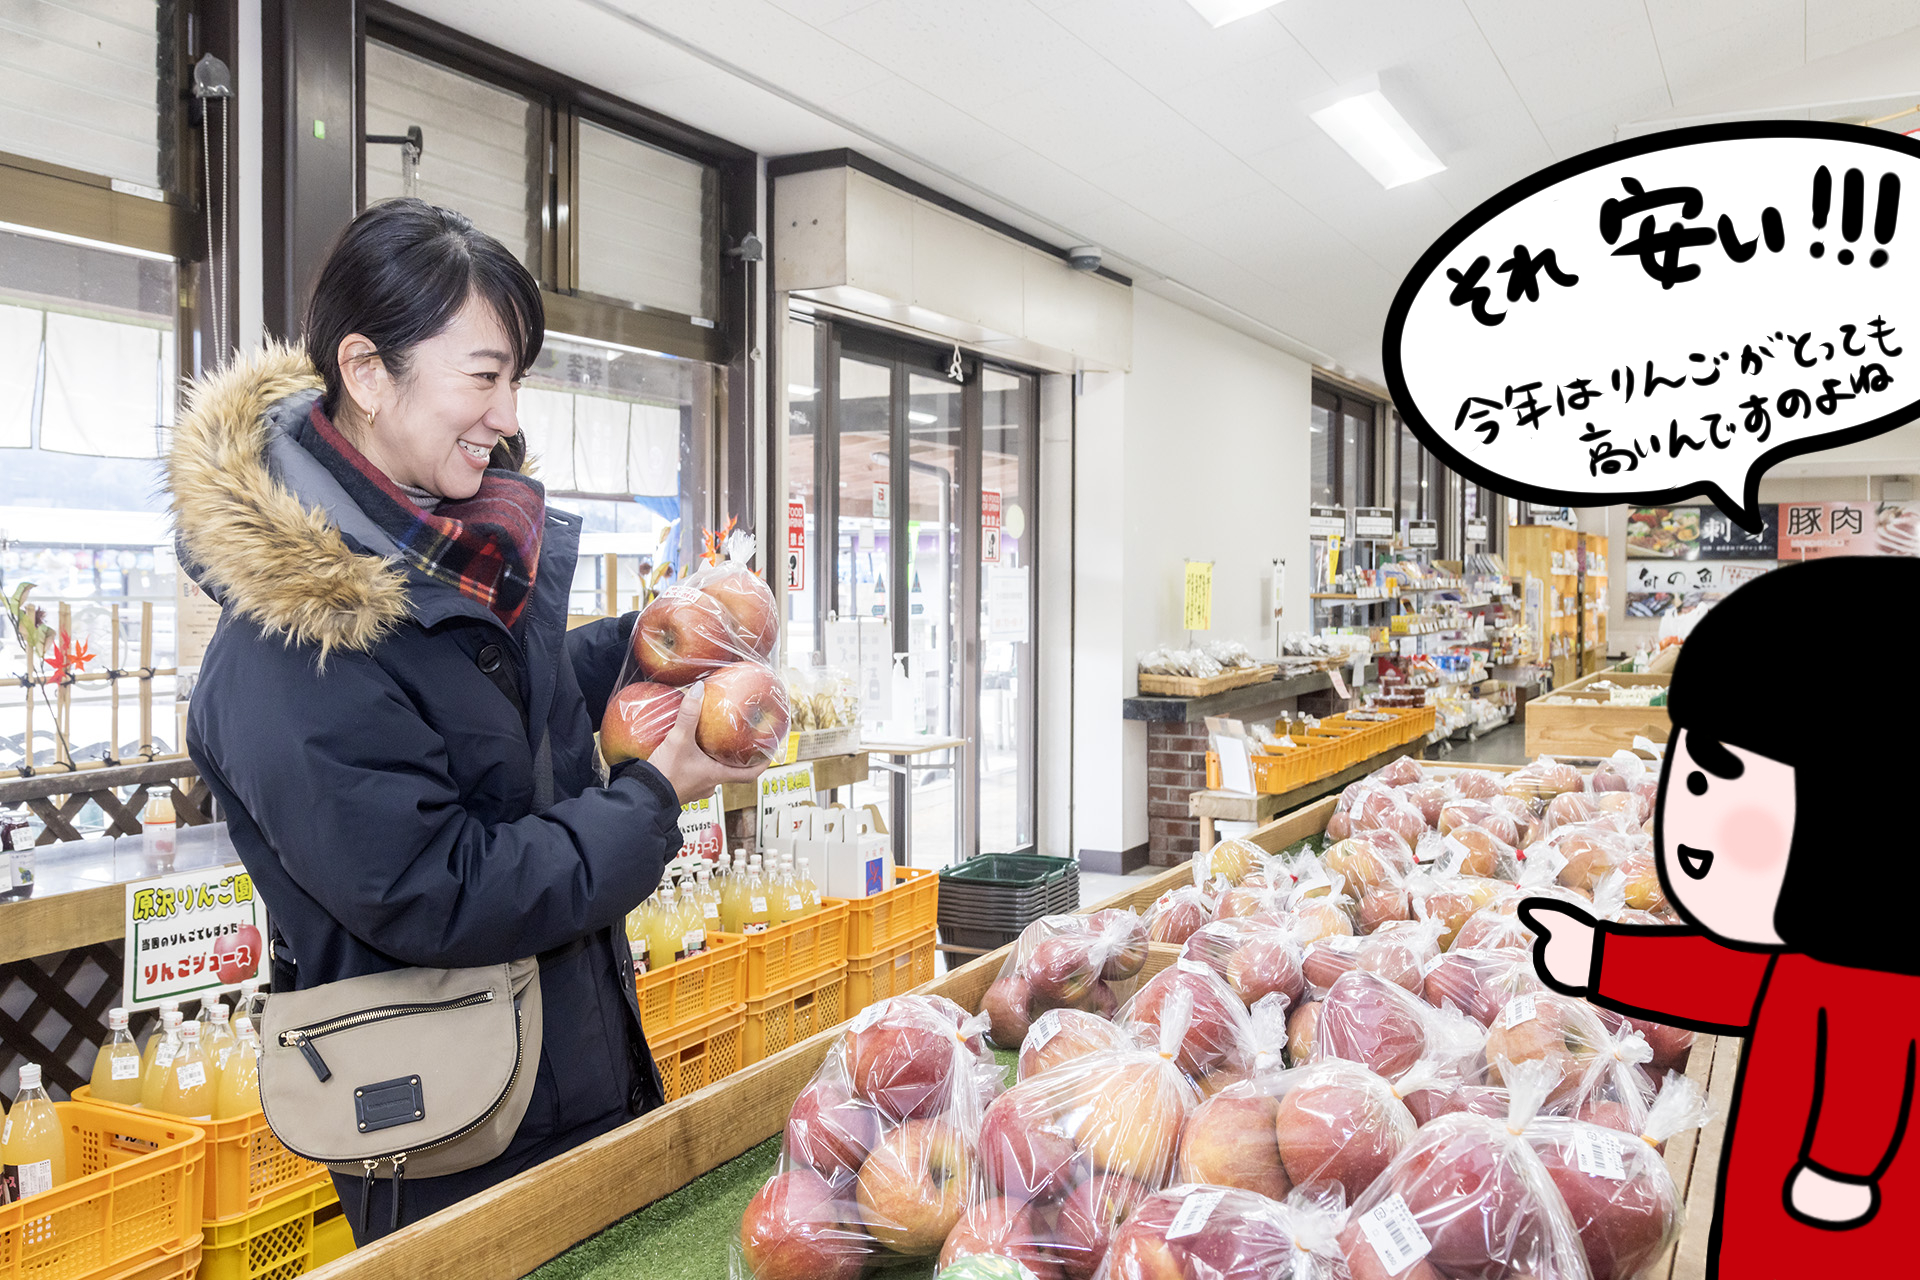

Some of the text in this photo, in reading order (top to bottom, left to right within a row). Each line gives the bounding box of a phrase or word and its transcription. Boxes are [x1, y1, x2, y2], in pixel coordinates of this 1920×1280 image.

[789, 507, 803, 518] OOD
[1788, 506, 1862, 535] 豚肉
[1639, 567, 1718, 590] 旬の魚
[677, 838, 718, 858] ごジュース
[133, 872, 253, 921] 原沢りんご園
[141, 922, 238, 951] 当園のりんごでしぼった
[144, 946, 251, 985] りんごジュース
